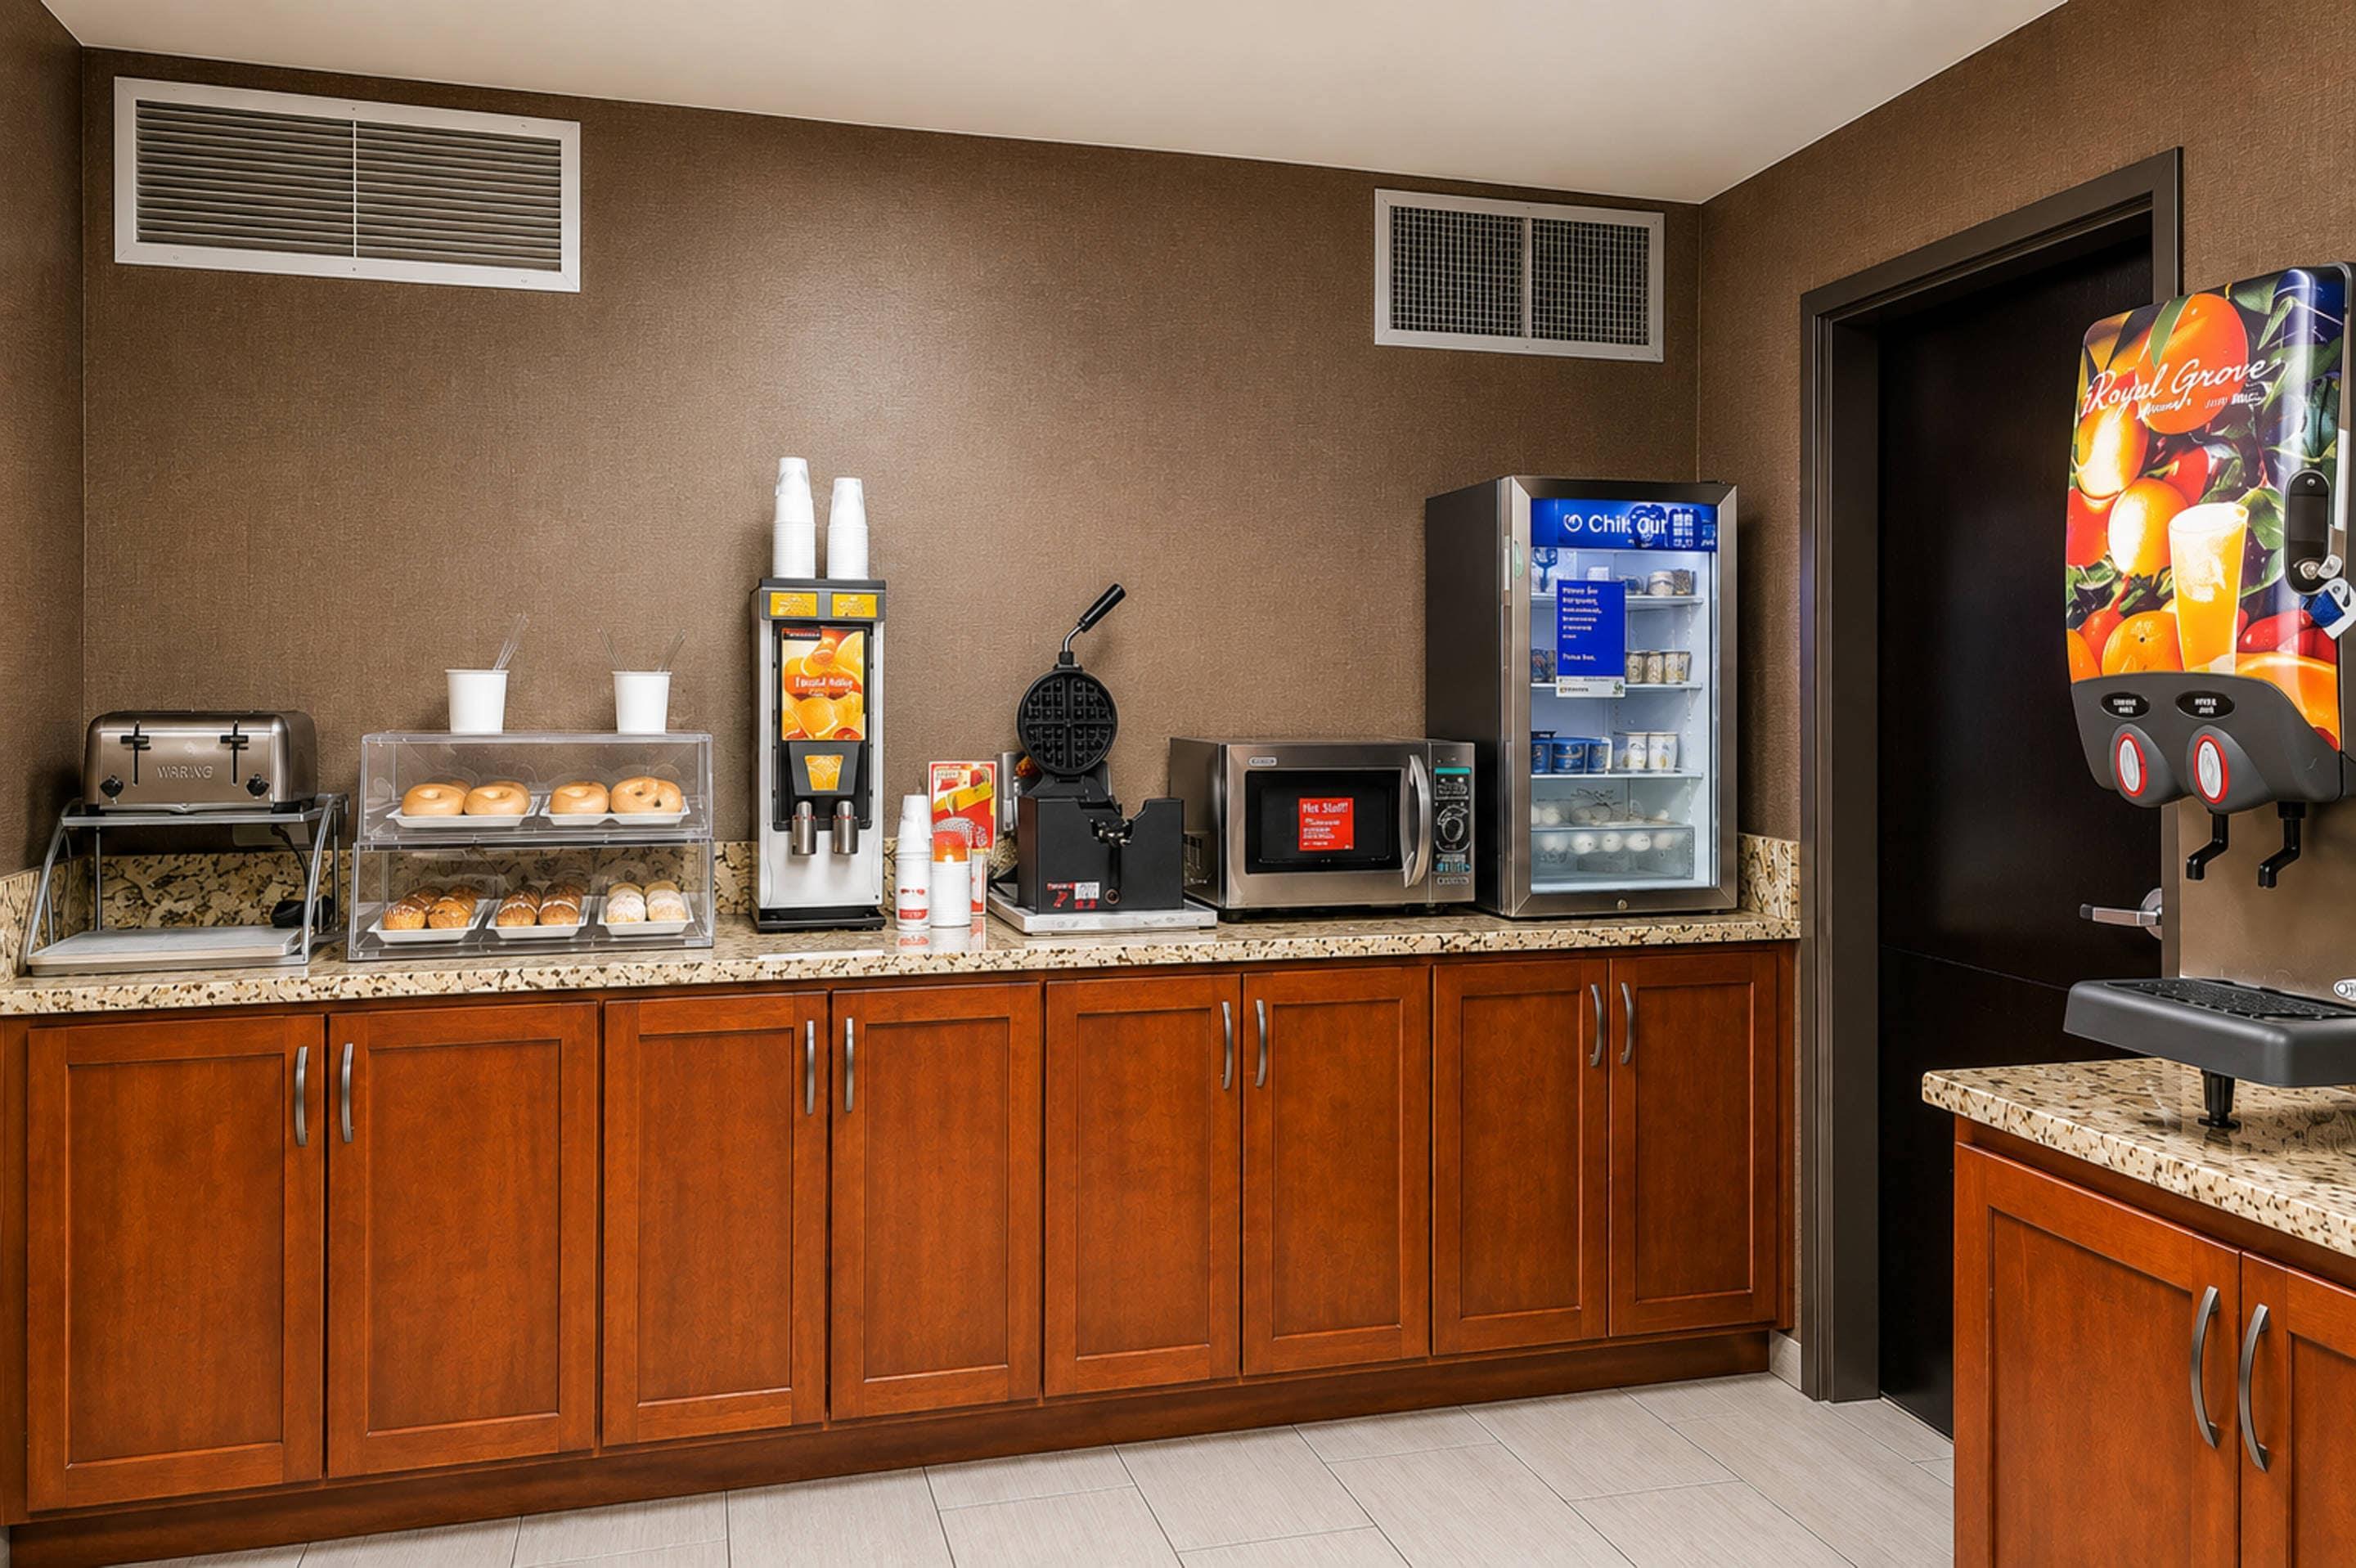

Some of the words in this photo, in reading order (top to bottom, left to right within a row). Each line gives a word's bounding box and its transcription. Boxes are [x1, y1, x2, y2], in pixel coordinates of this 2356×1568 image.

[2081, 363, 2168, 421] Royal
[2171, 358, 2281, 406] Grove
[156, 765, 214, 780] WARING
